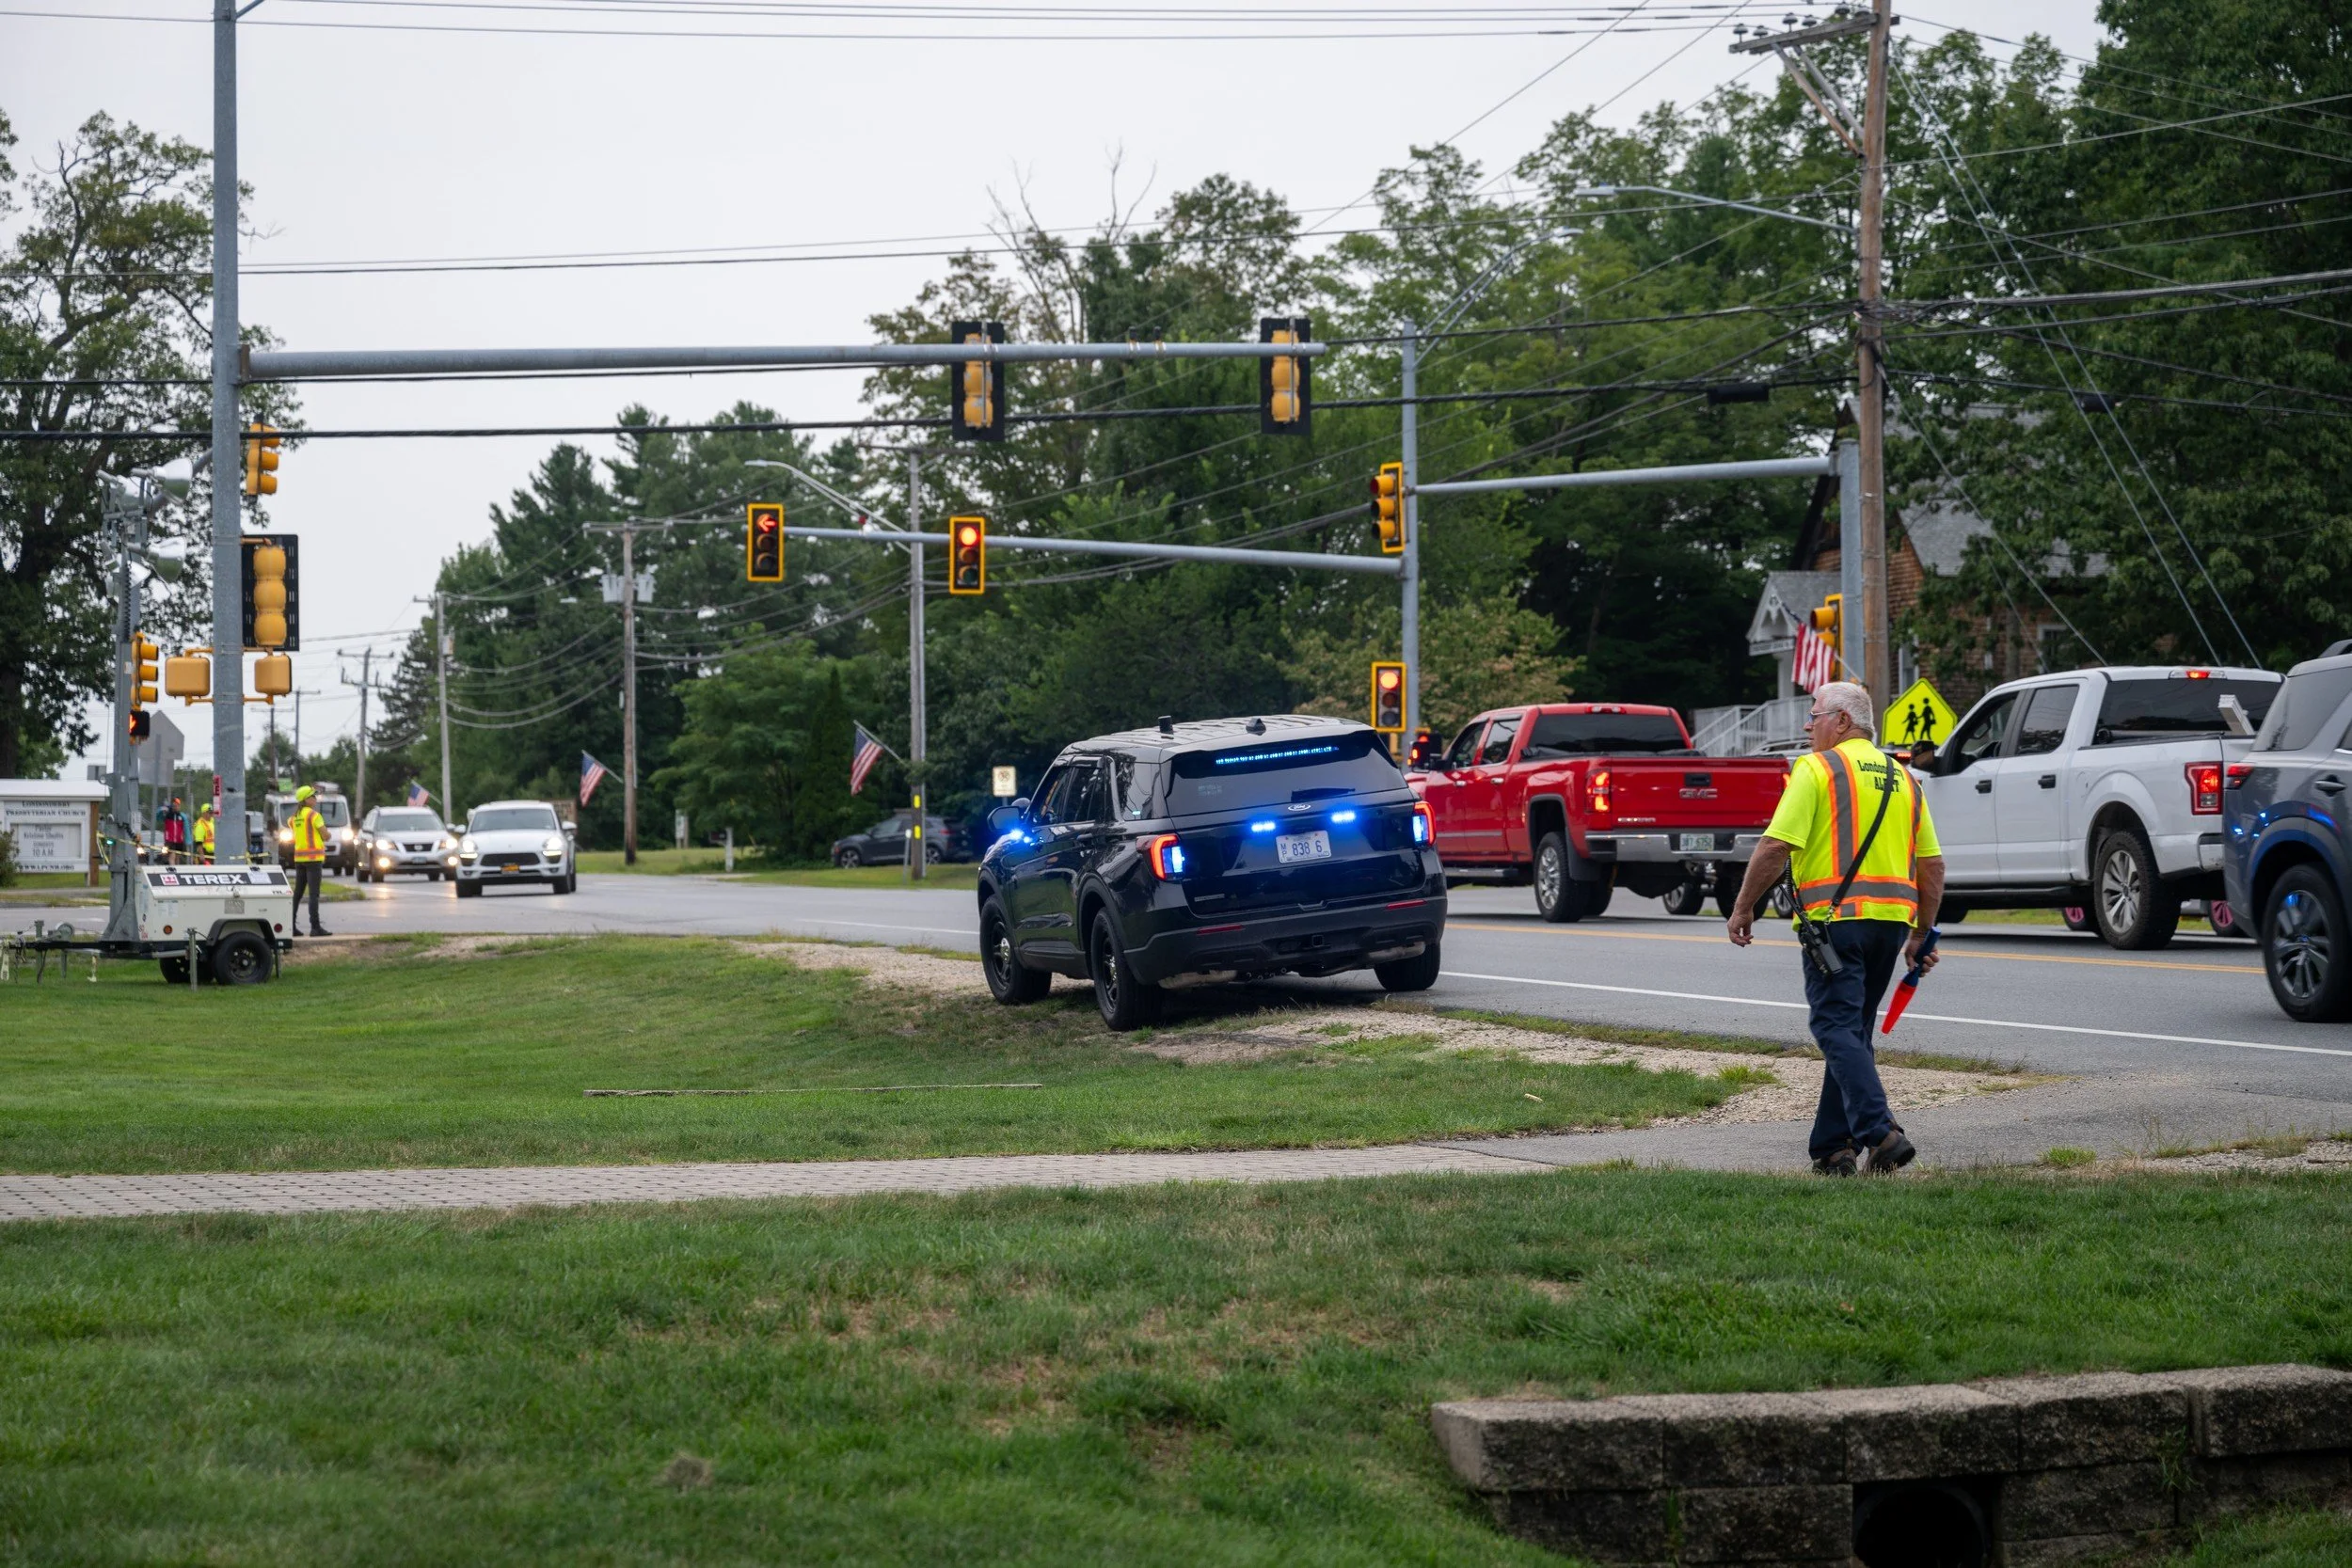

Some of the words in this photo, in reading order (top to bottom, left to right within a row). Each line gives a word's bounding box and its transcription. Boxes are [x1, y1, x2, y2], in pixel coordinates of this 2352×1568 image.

[1679, 788, 1718, 799] GMC
[1292, 841, 1311, 856] 838
[1315, 840, 1323, 853] 6
[181, 873, 245, 885] TEREX
